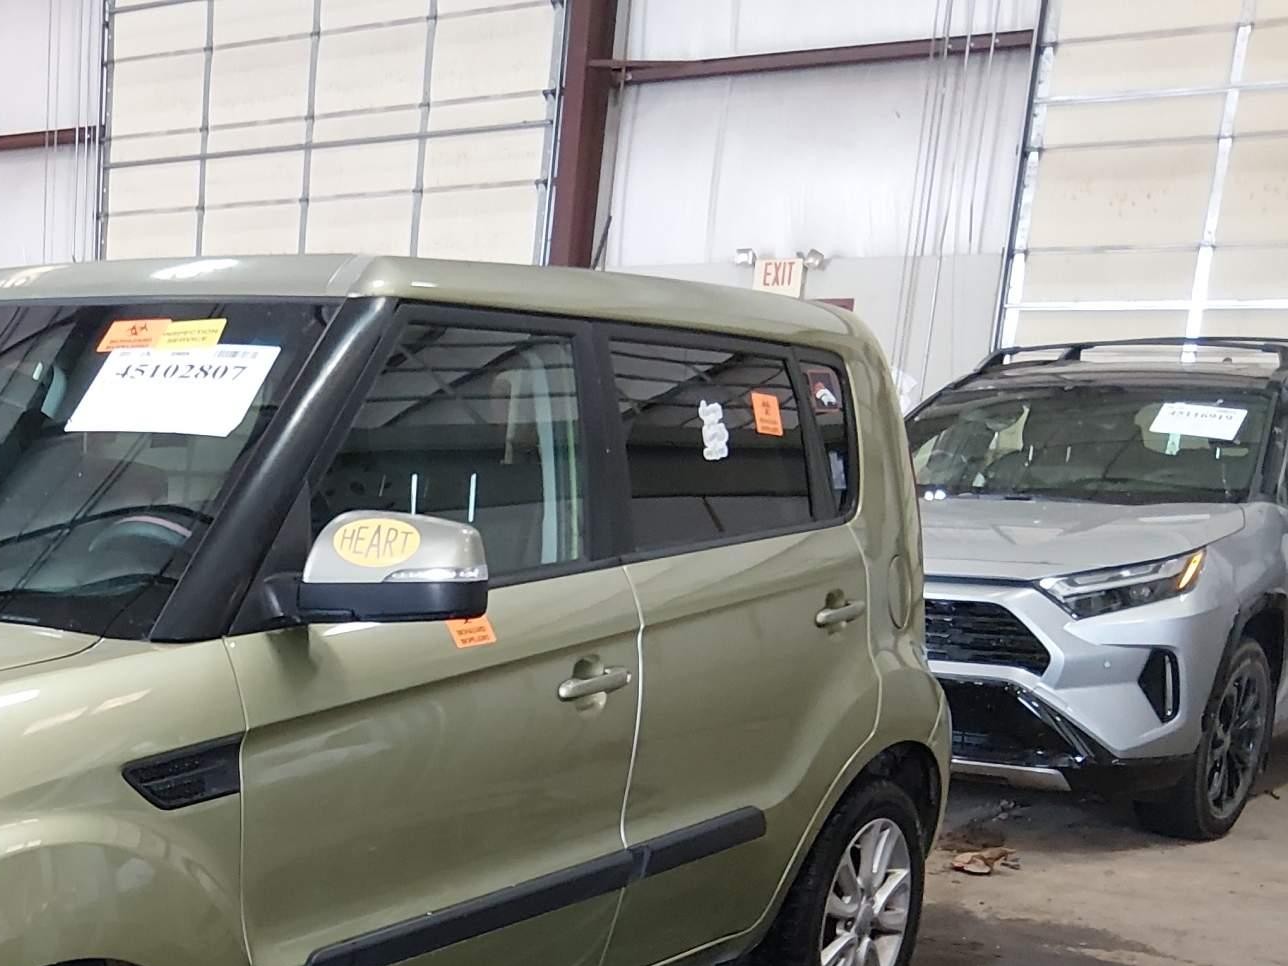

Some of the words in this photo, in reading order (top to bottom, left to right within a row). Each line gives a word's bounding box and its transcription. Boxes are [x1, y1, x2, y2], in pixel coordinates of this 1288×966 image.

[762, 261, 796, 287] EXIT
[114, 363, 247, 381] 45102807
[340, 524, 416, 560] HEART
